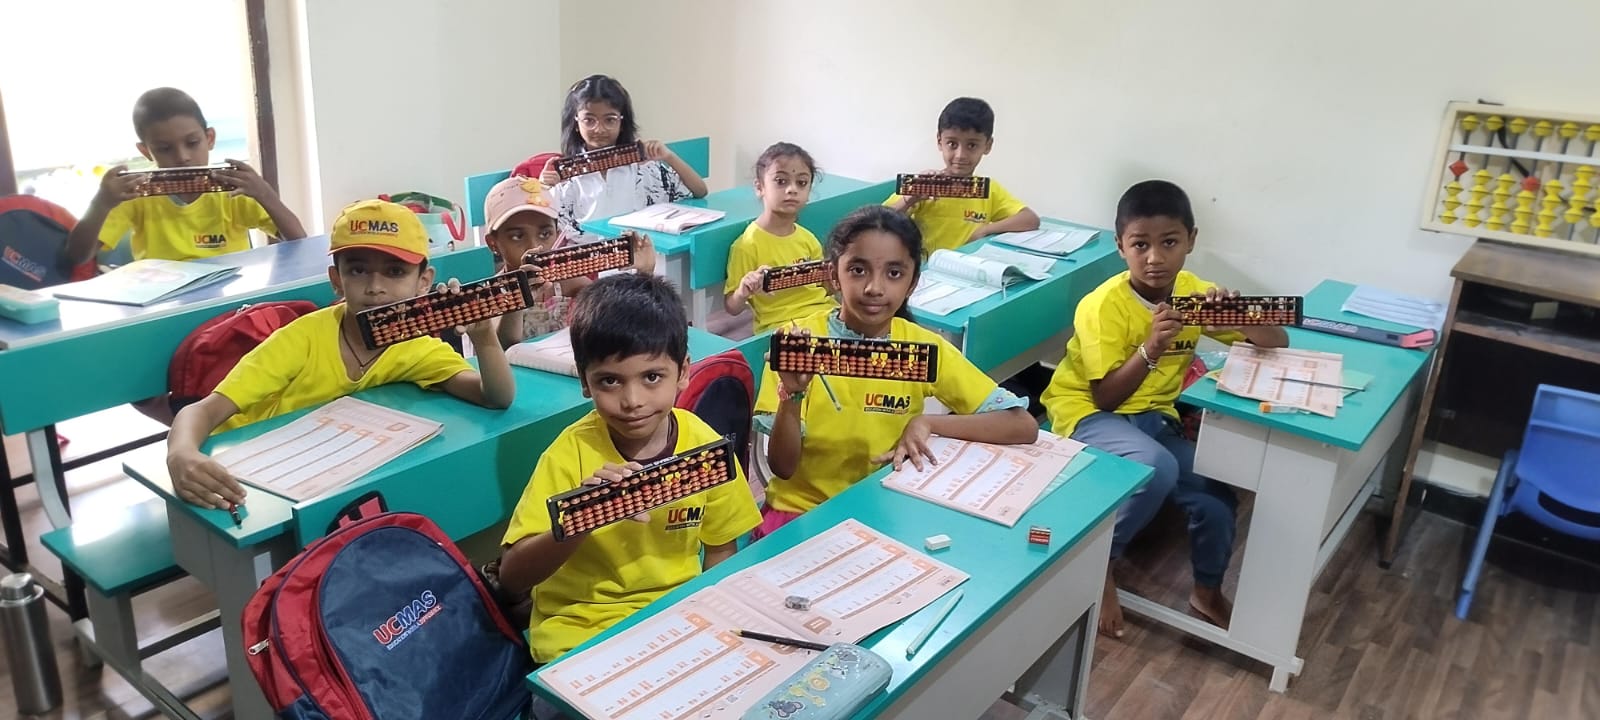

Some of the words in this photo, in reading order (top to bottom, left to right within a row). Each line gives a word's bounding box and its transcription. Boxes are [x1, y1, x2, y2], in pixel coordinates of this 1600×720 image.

[350, 220, 399, 233] UCMAS
[193, 234, 227, 244] UCMA
[373, 590, 437, 645] UCMAS
